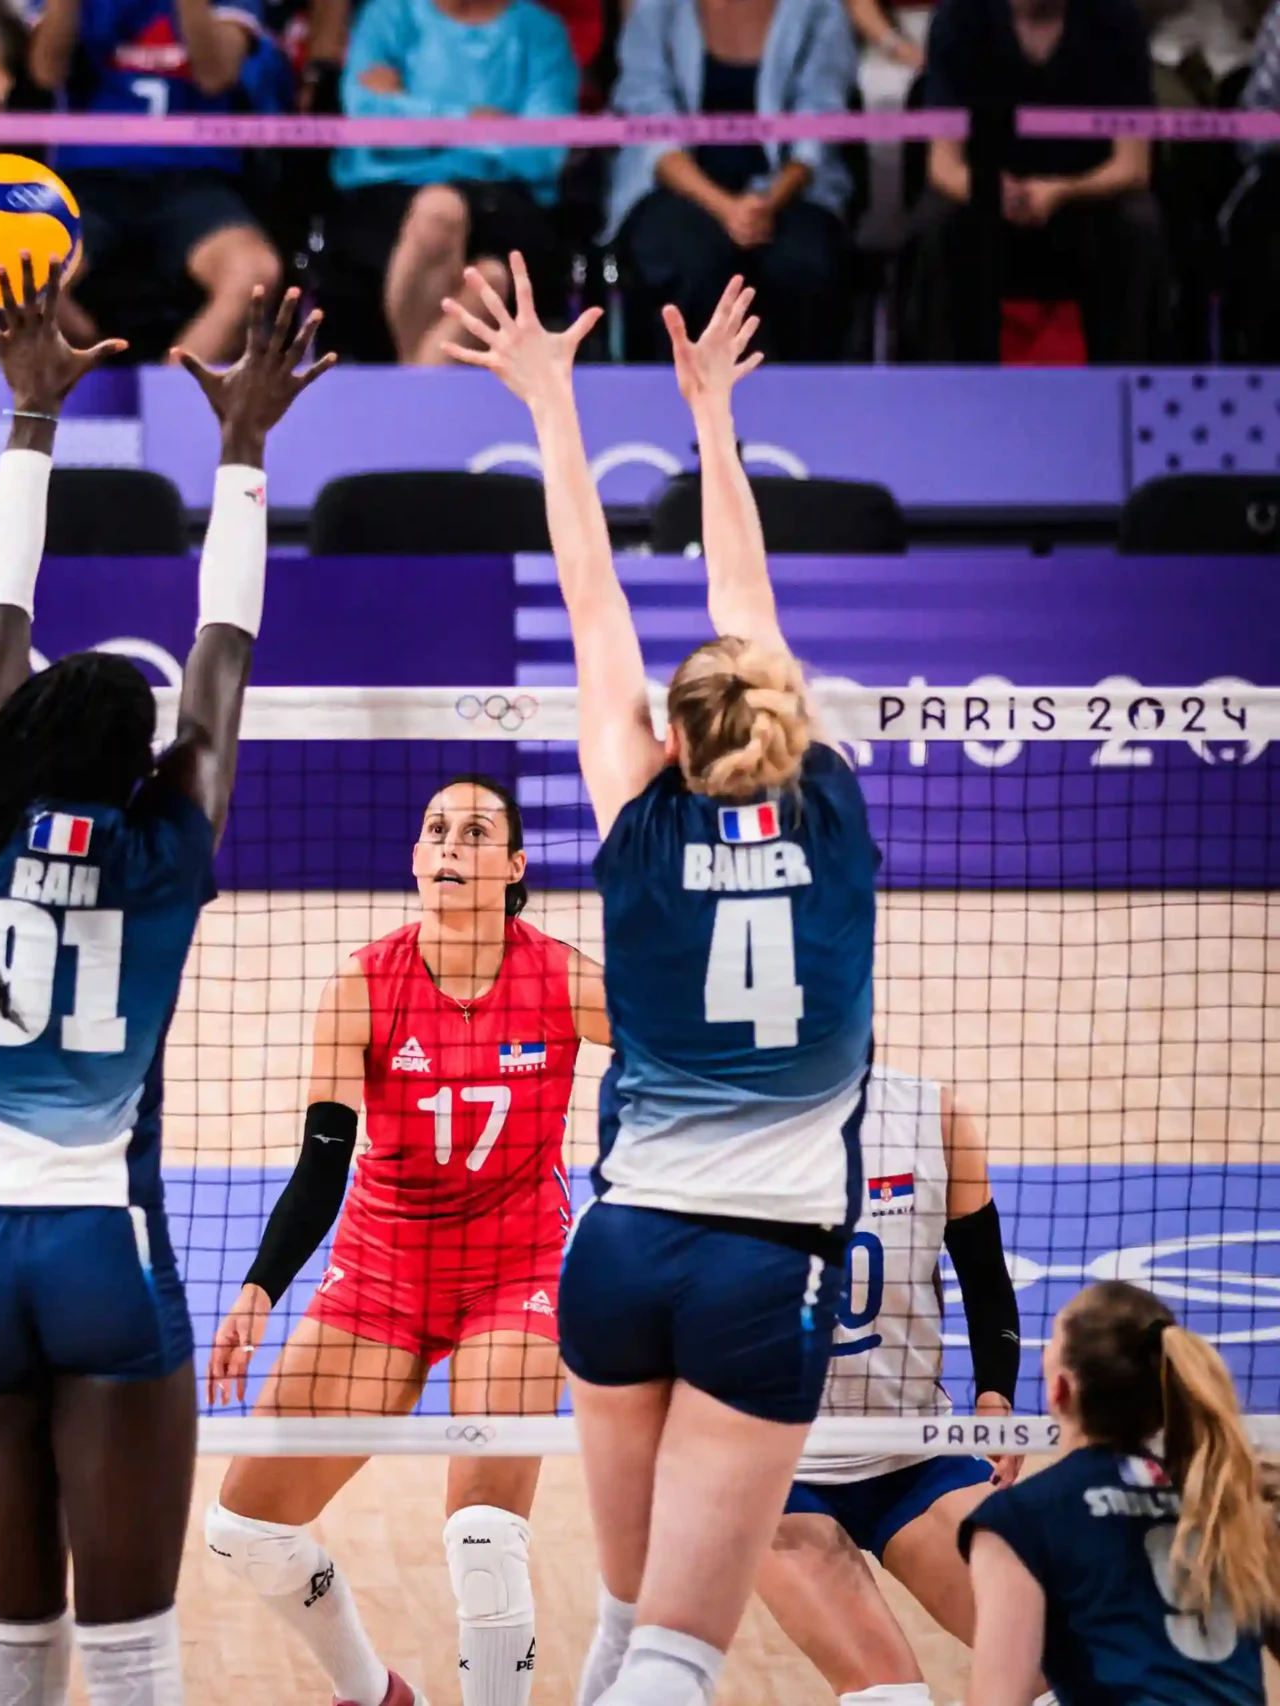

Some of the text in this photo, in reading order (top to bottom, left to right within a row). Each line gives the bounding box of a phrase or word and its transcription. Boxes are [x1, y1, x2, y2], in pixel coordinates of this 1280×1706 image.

[1087, 696, 1247, 731] 2024
[11, 856, 101, 907] BAH
[683, 840, 813, 892] BAUER
[704, 896, 804, 1049] 4
[391, 1056, 433, 1073] PEAK
[500, 1063, 547, 1073] SERBIA
[417, 1086, 512, 1171] 17
